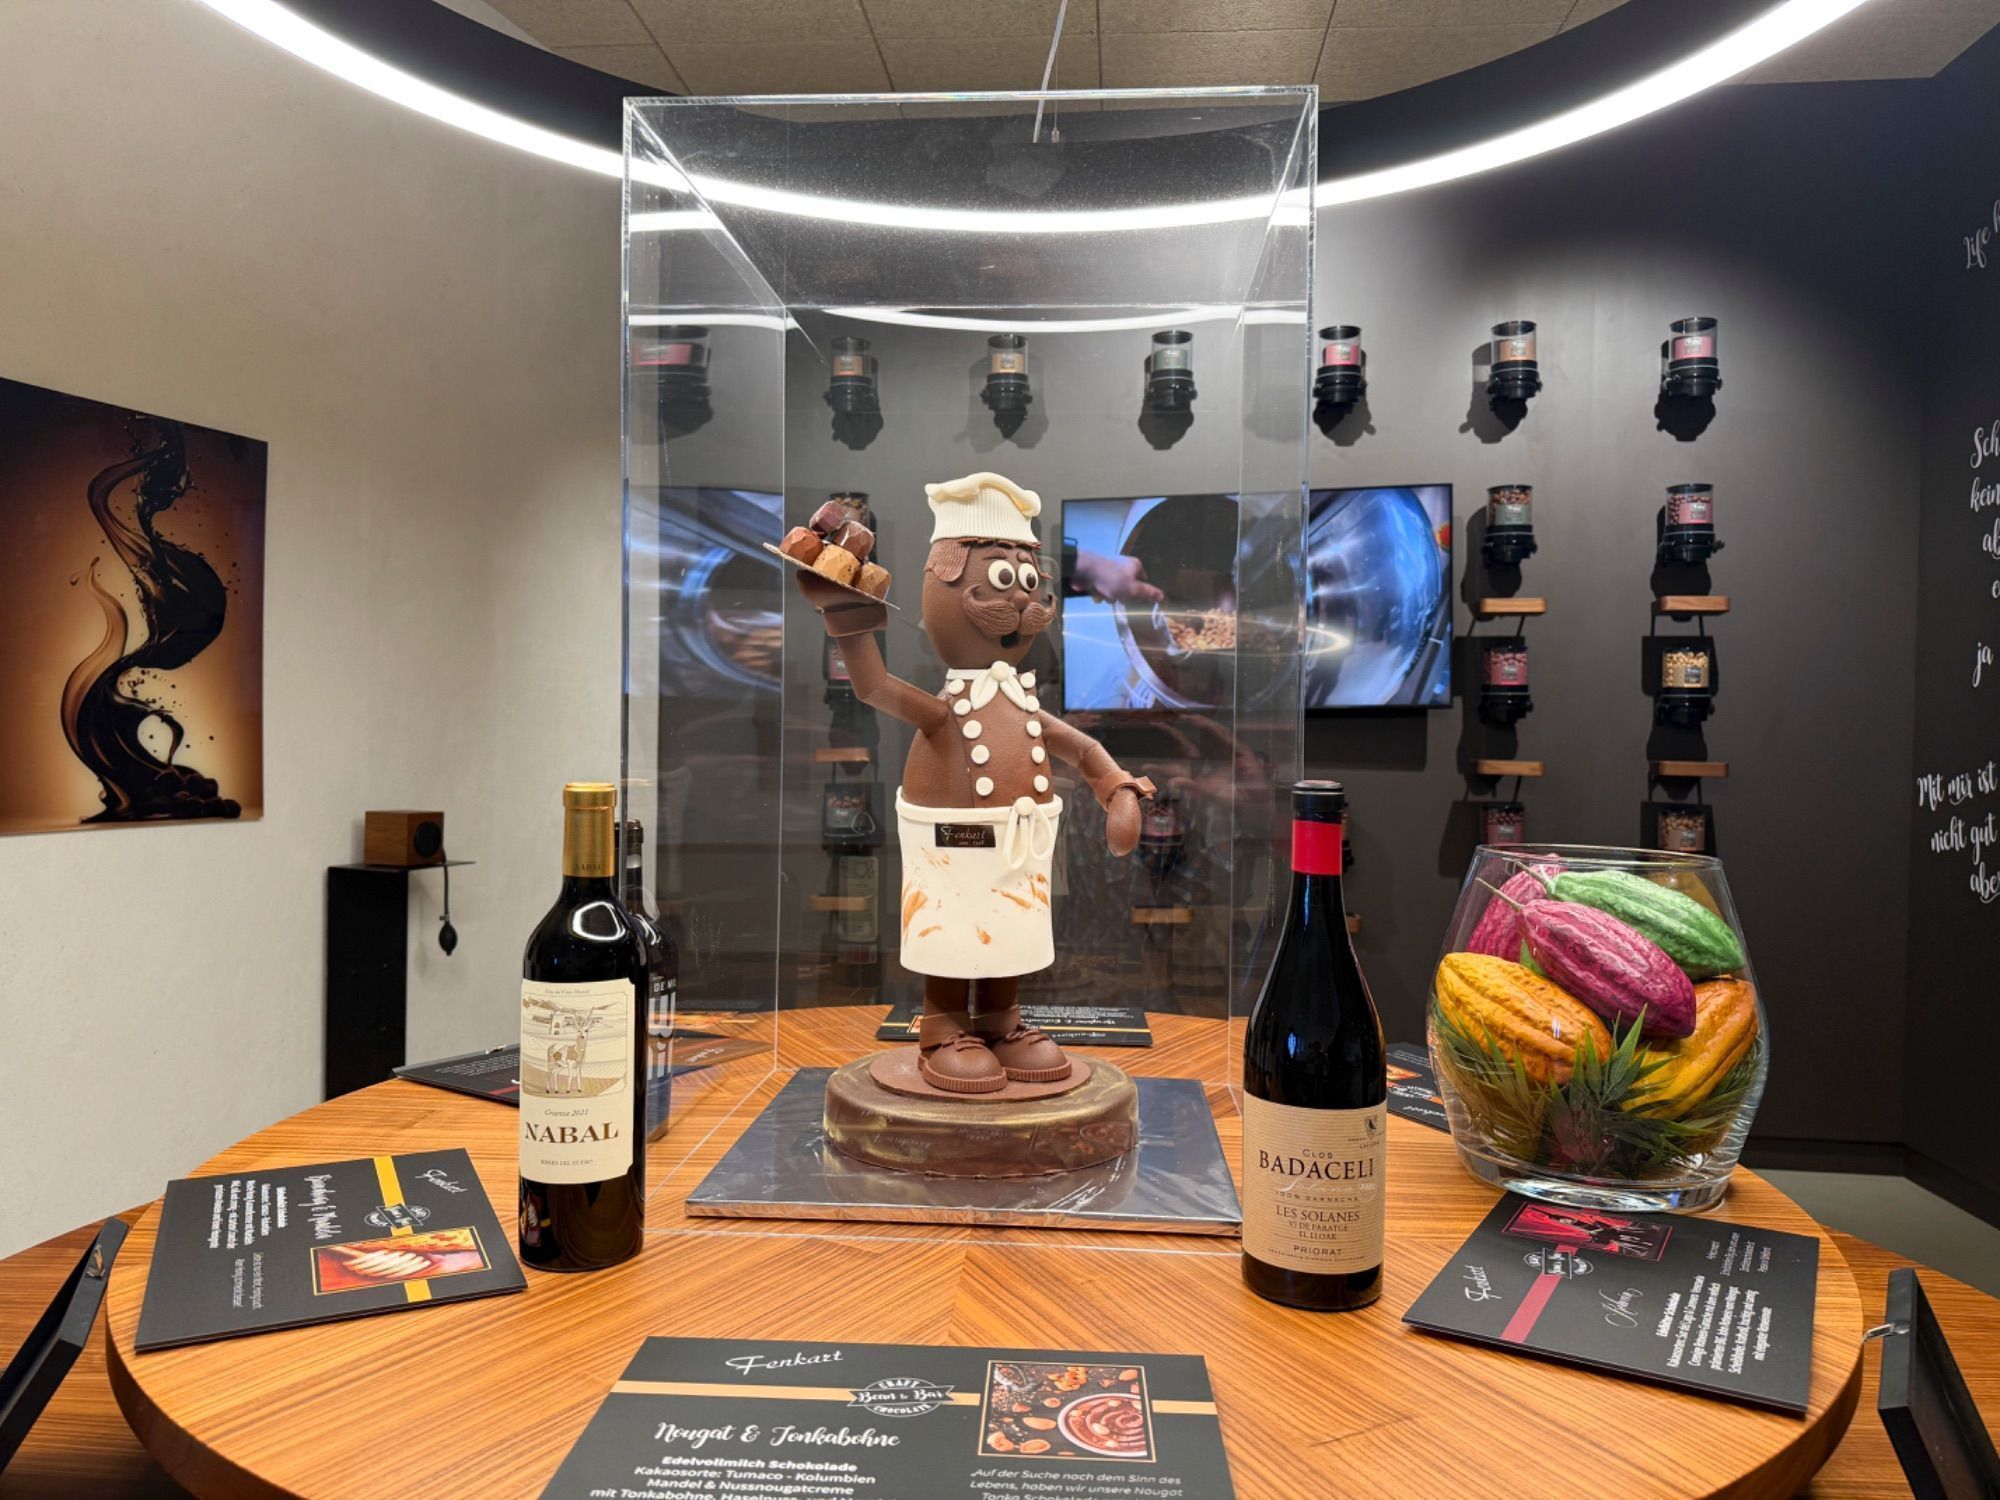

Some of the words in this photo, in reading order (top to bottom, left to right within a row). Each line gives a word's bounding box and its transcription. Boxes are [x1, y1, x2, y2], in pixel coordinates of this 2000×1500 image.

[1972, 642, 1993, 688] ja
[1917, 773, 1945, 812] Mit
[1948, 772, 1973, 805] mir
[1978, 760, 1998, 794] ist
[1931, 816, 1967, 853] nicht
[1970, 812, 1998, 865] gut
[525, 1121, 619, 1145] NABAL
[1259, 1150, 1374, 1180] BADACELI
[1276, 1205, 1298, 1219] LES
[1300, 1209, 1360, 1223] SOLANES
[1293, 1245, 1343, 1256] PRIORAT
[725, 1350, 844, 1376] Fenkart
[654, 1422, 737, 1449] Nougat
[740, 1424, 761, 1442] &
[769, 1426, 900, 1447] Tonkabohne
[661, 1456, 765, 1469] Edelvollmilch
[768, 1460, 858, 1472] Schokolade
[634, 1466, 722, 1478] Kakaosorte:
[726, 1469, 783, 1480] Tumaco
[795, 1473, 876, 1484] Kolumbien
[997, 1469, 1019, 1478] der
[1021, 1470, 1060, 1479] Suche
[1062, 1473, 1094, 1481] nach
[1096, 1474, 1125, 1482] dem
[1128, 1475, 1156, 1483] Sinn
[1159, 1476, 1181, 1485] des
[590, 1488, 616, 1498] mit
[646, 1478, 702, 1489] Mandel
[704, 1480, 716, 1490] &
[719, 1481, 854, 1495] Nussnougatcreme
[1021, 1482, 1062, 1491] haben
[1065, 1484, 1086, 1492] wir
[1088, 1486, 1131, 1494] unsere
[1134, 1487, 1183, 1497] Nougat
